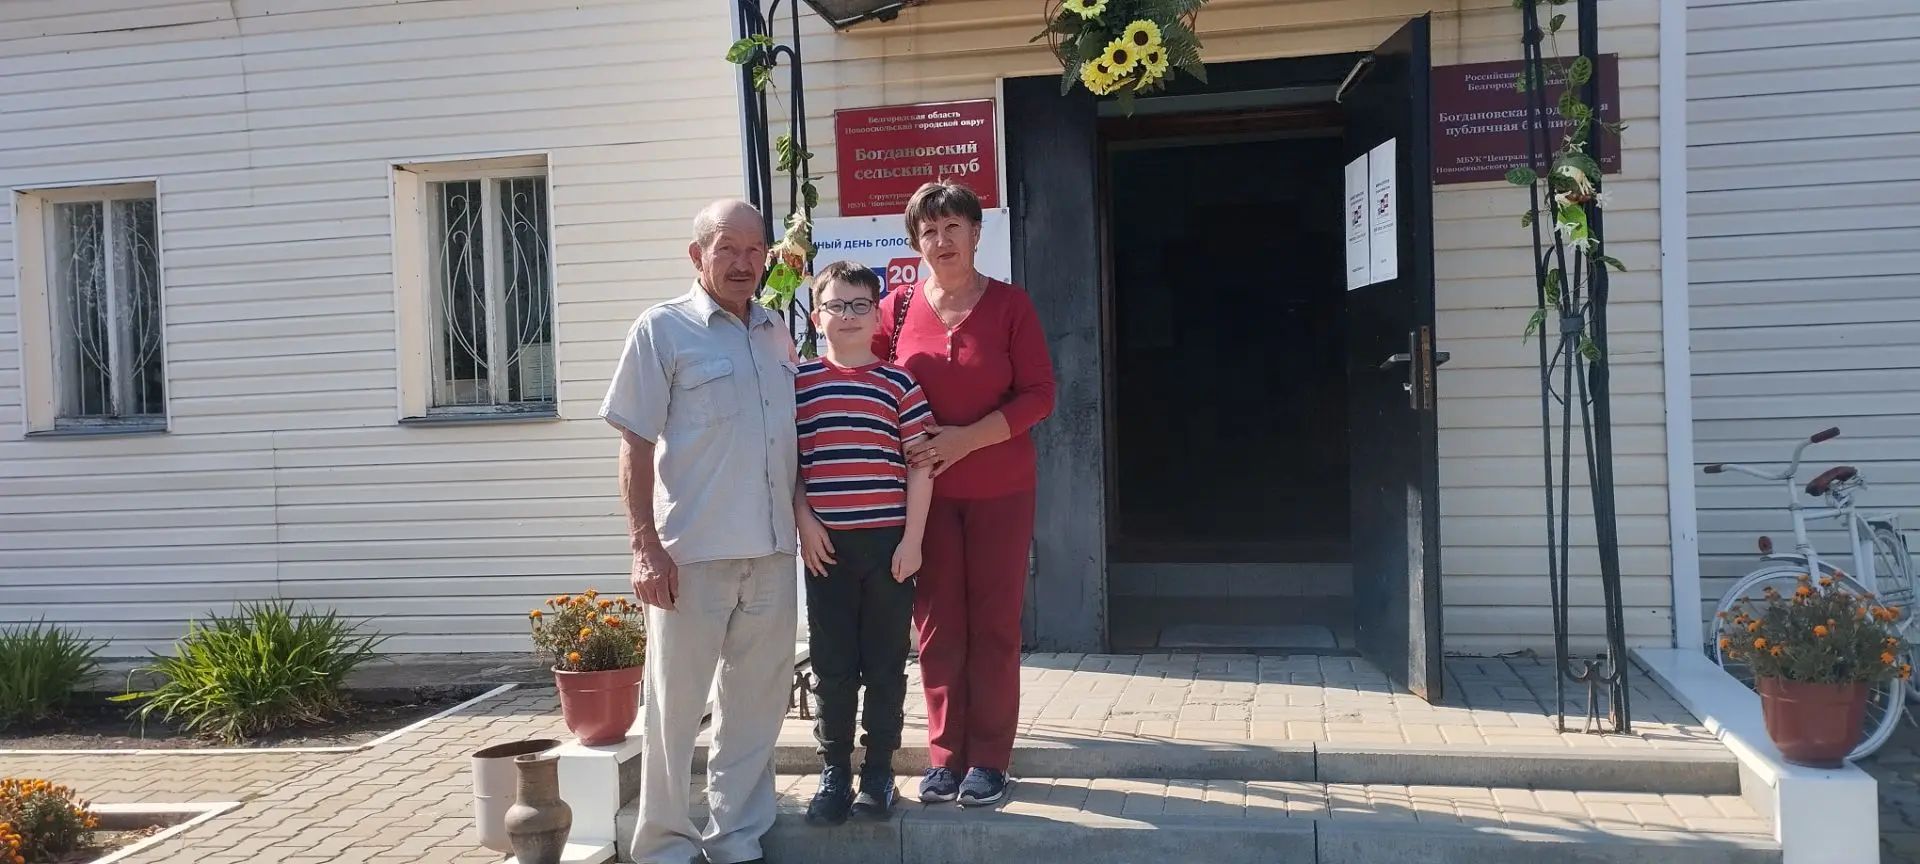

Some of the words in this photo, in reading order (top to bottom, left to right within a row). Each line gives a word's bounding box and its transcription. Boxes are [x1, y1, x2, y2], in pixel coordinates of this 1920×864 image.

[1465, 71, 1520, 81] Российская
[1468, 80, 1519, 91] Белгородс
[928, 111, 960, 119] область
[915, 119, 958, 130] городской
[960, 118, 984, 127] округ
[1446, 123, 1518, 137] публичная
[855, 140, 977, 161] Богдановский
[854, 163, 932, 180] сельский
[938, 158, 980, 176] клуб
[844, 240, 872, 249] ДЕНЬ
[889, 265, 916, 284] 20
